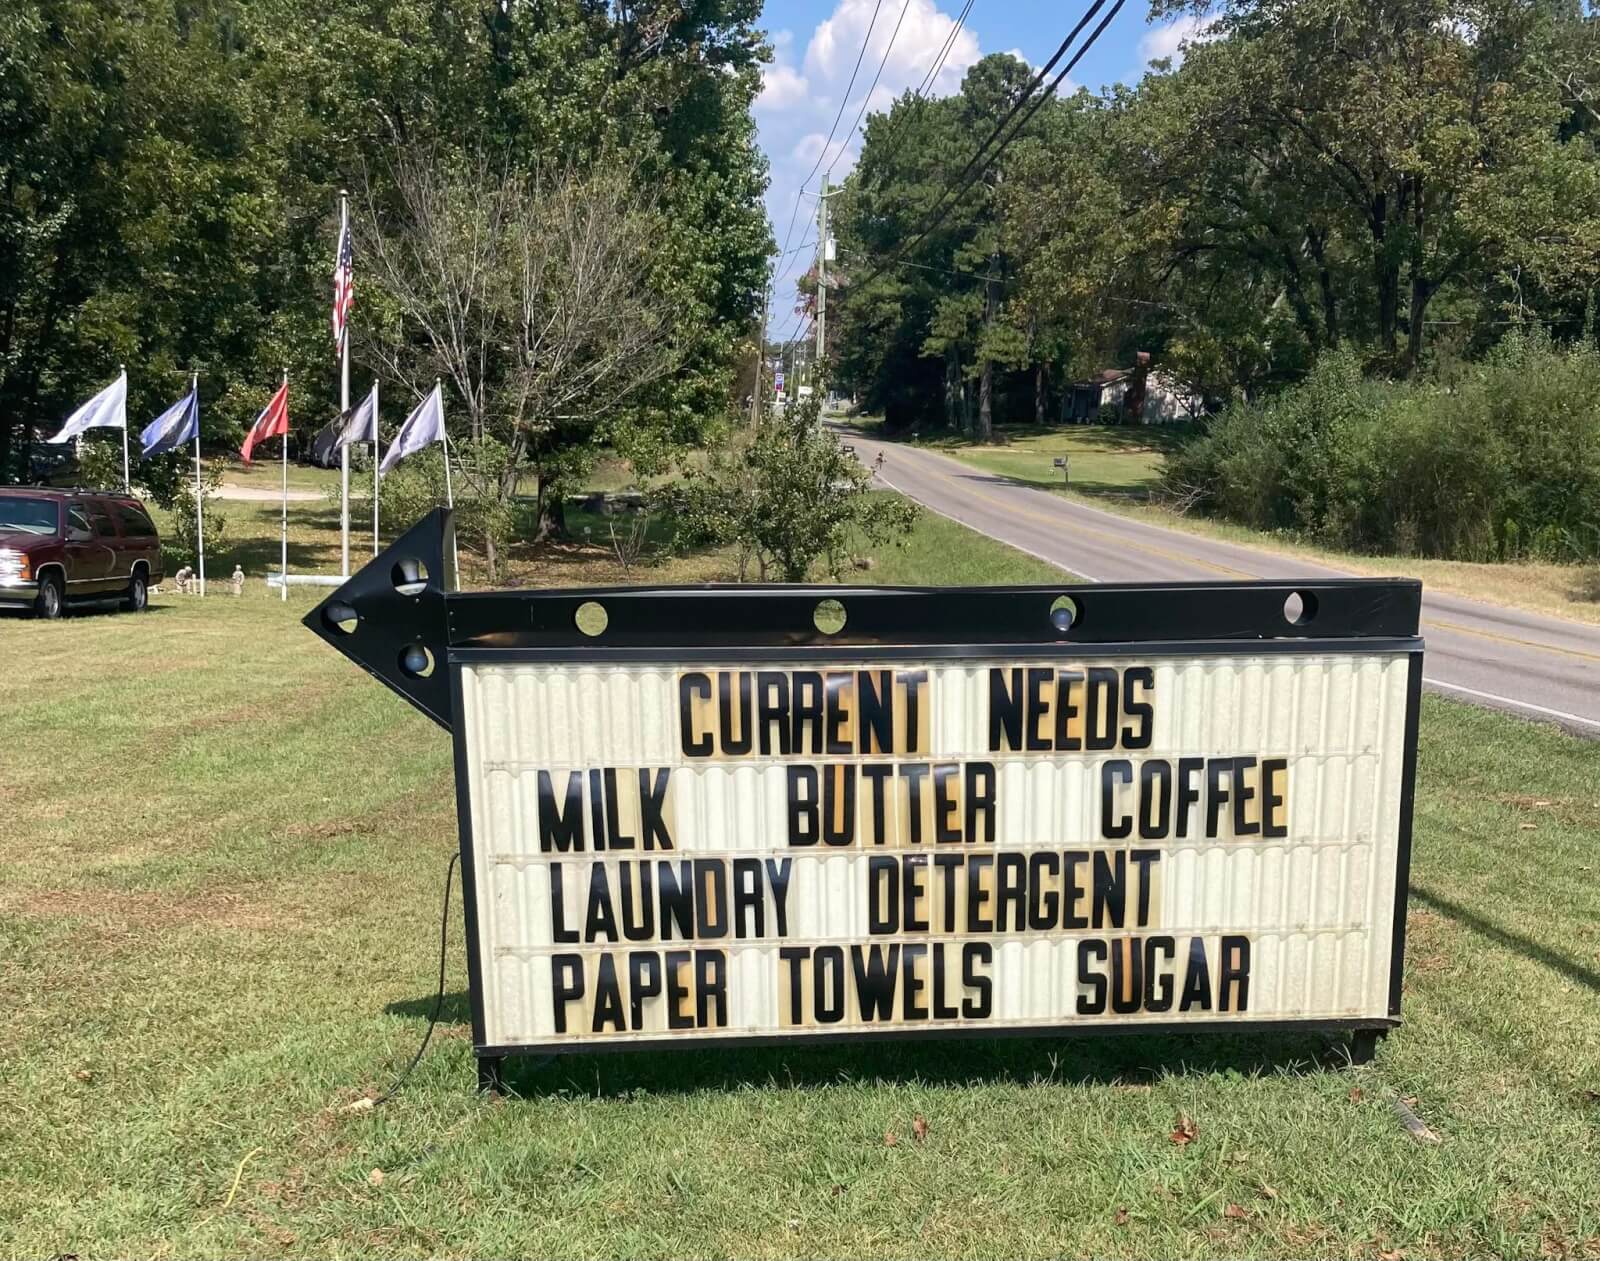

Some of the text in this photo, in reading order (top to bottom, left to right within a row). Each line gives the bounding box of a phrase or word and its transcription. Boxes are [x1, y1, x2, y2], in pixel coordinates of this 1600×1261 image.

[679, 667, 1154, 757] CURRENT NEEDS
[537, 757, 1288, 852] MILK BUTTER COFFEE
[550, 849, 1160, 943] LAUNDRY DETERGENT
[552, 935, 1251, 1033] PAPER TOWELS SUGAR
